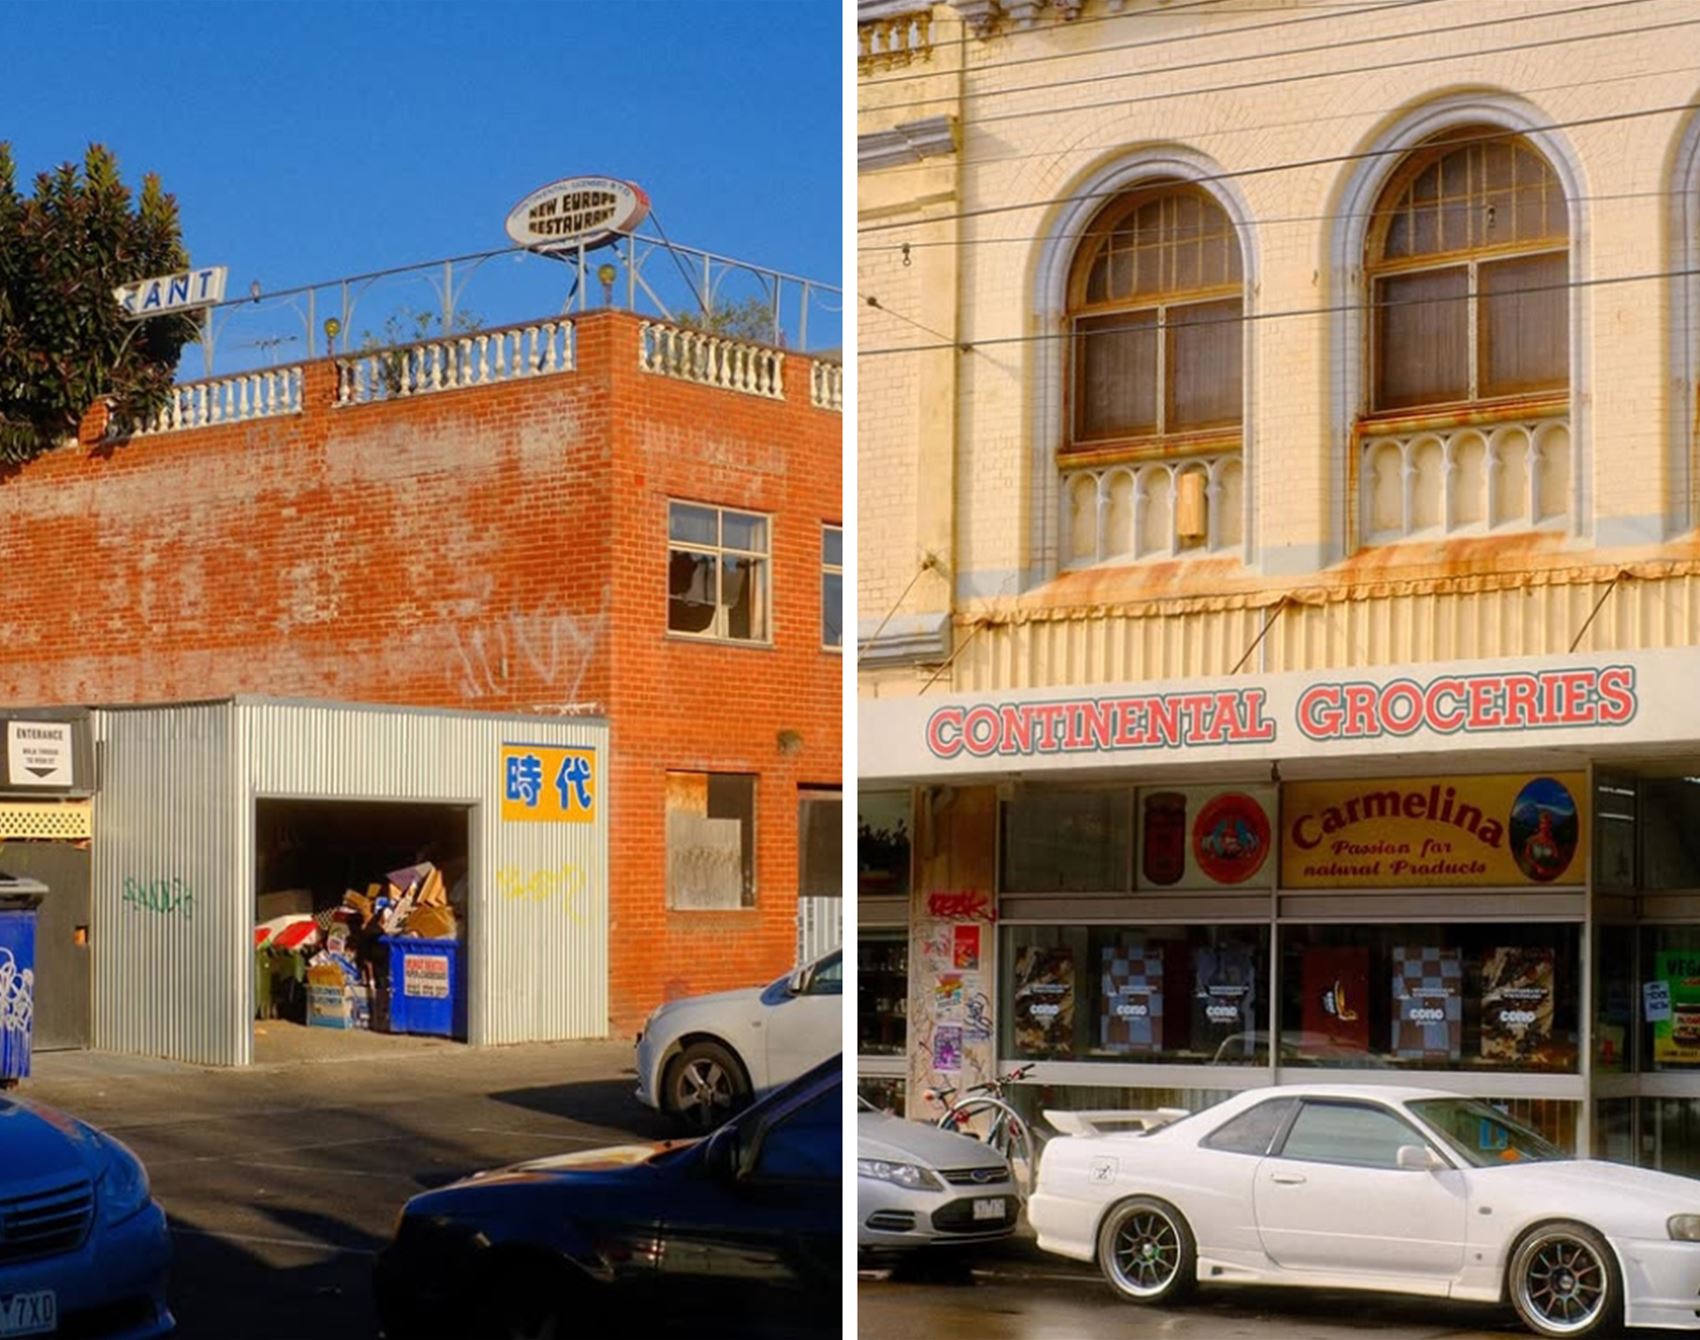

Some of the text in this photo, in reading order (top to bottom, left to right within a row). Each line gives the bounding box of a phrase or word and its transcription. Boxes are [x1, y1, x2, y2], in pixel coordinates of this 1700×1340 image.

[529, 191, 616, 220] NEW EUROPE
[528, 206, 616, 235] RESTAURANT
[927, 666, 1637, 759] CONTINENTAL GROCERIES
[16, 727, 64, 741] ENTERANCE
[506, 754, 592, 810] 時代
[1291, 784, 1504, 850] Carmelina
[1331, 838, 1453, 859] Passion for
[1304, 859, 1487, 877] natural Products
